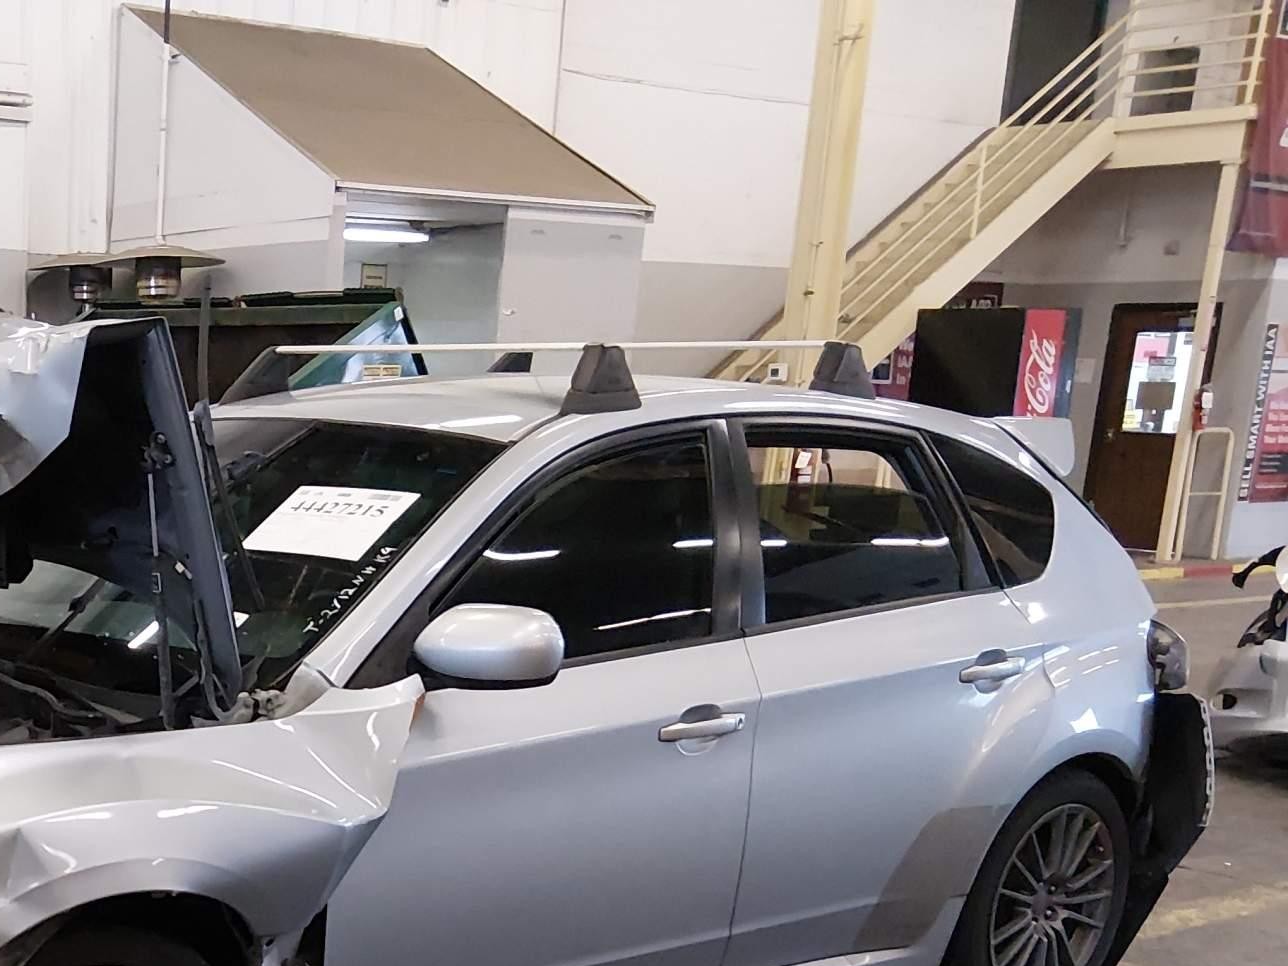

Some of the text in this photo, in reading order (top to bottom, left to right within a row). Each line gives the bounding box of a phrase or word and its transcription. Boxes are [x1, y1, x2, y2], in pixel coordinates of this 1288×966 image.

[1239, 327, 1278, 498] SELL SMART WITH IAA
[291, 500, 389, 517] 44427215
